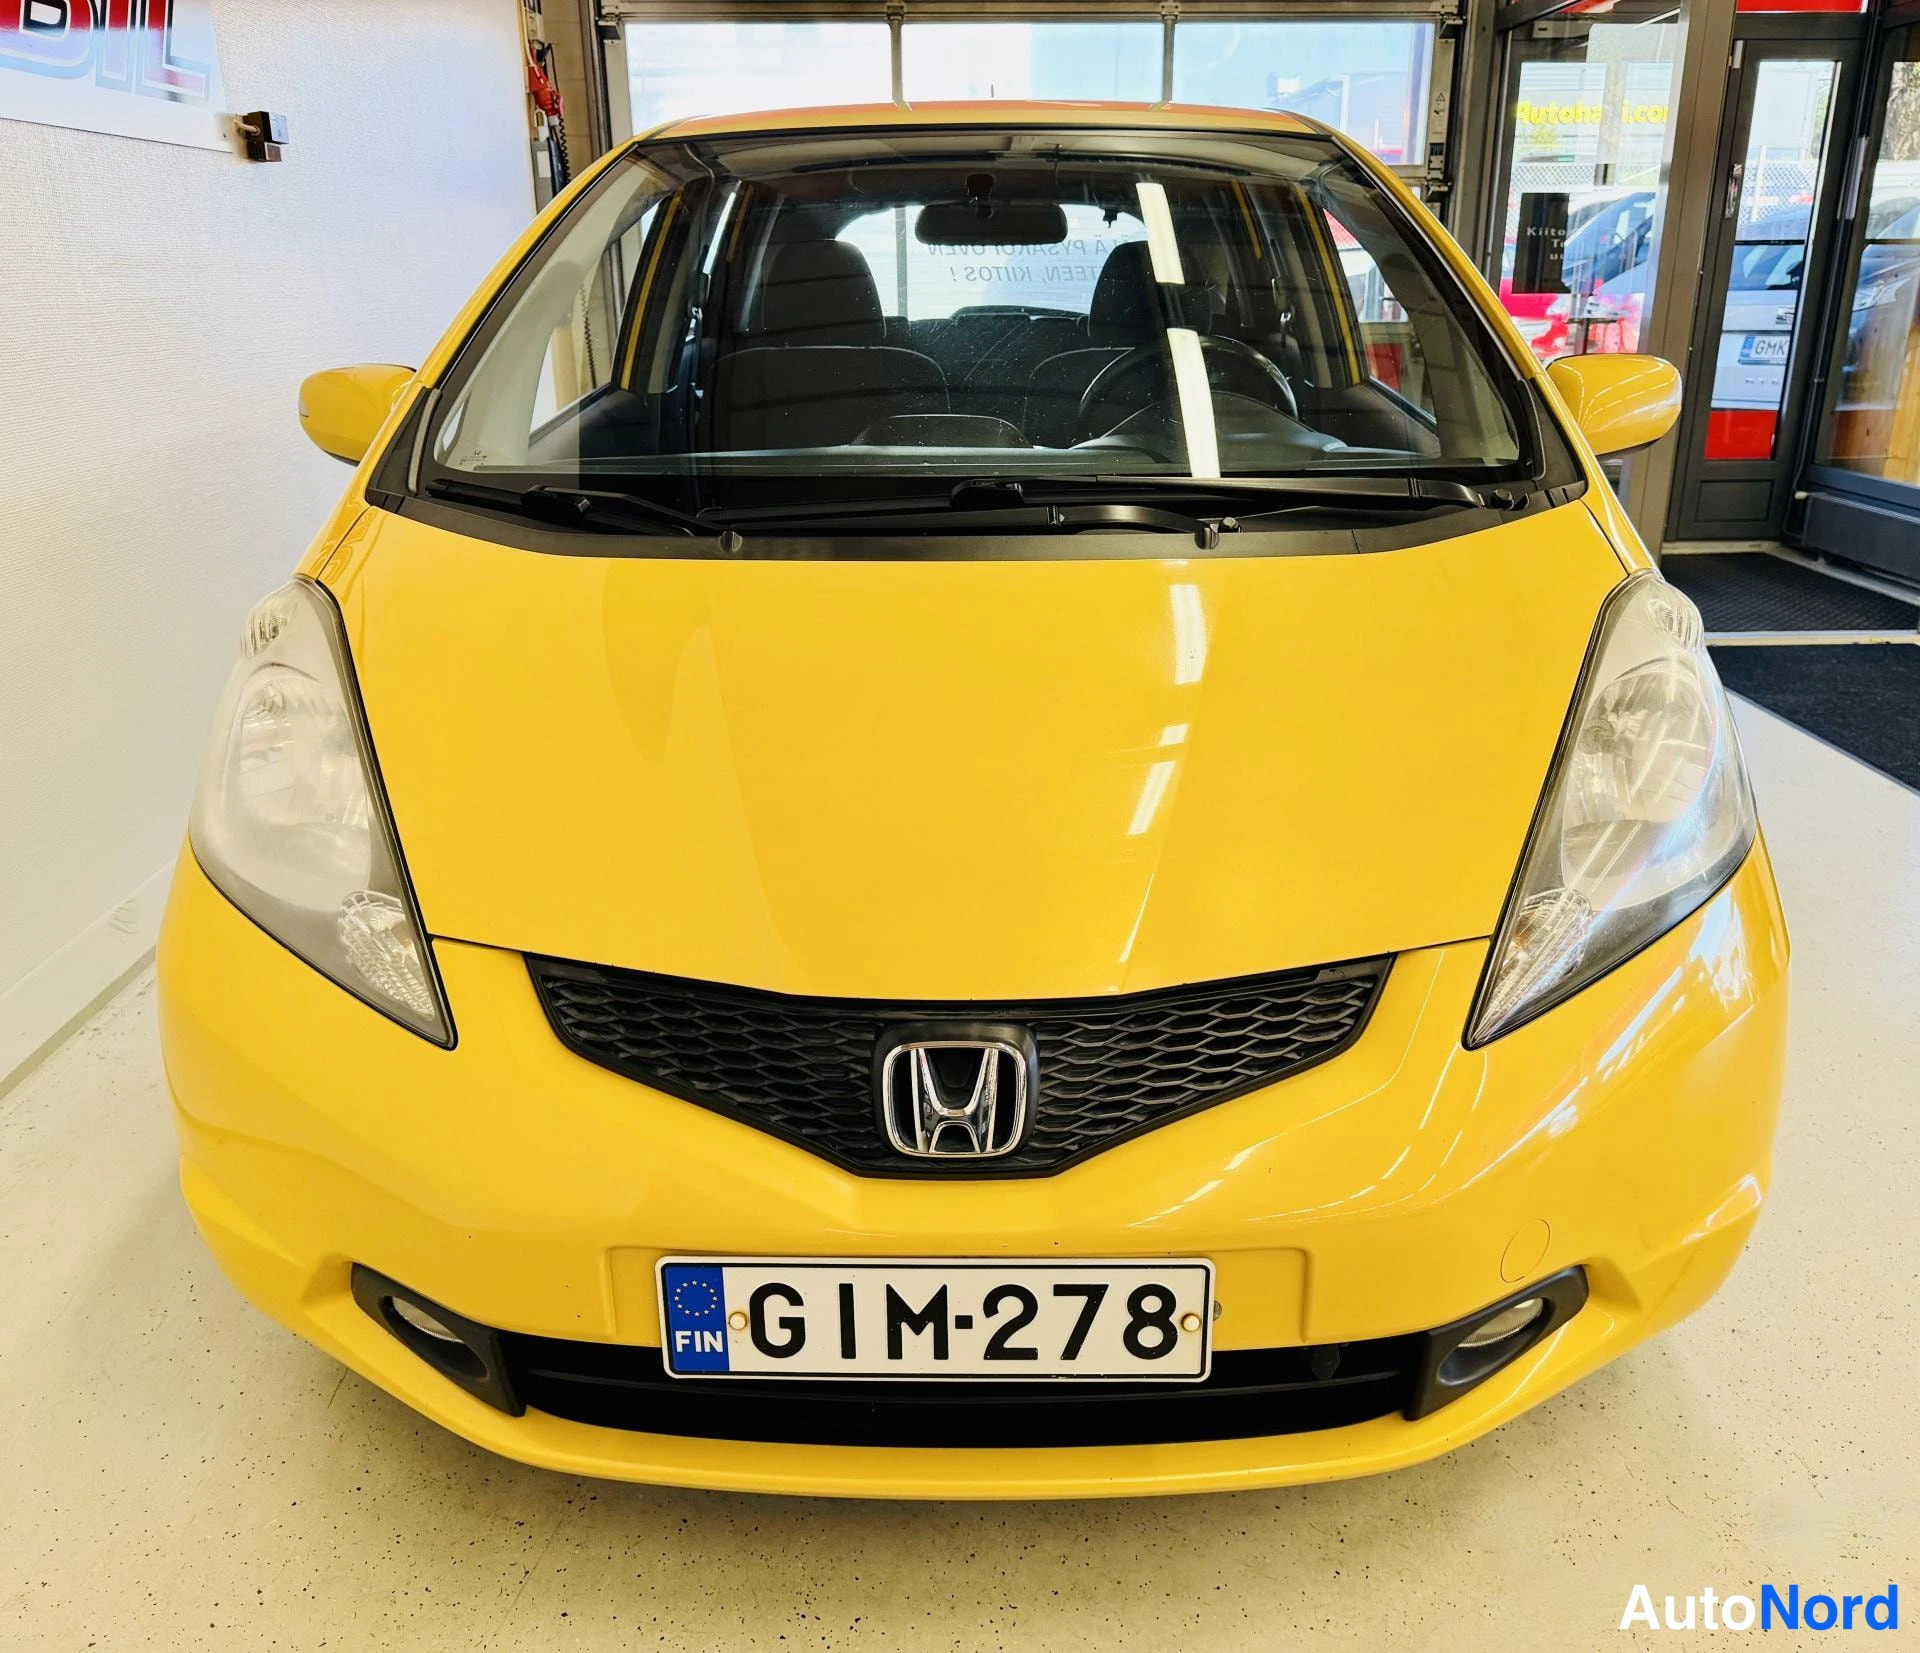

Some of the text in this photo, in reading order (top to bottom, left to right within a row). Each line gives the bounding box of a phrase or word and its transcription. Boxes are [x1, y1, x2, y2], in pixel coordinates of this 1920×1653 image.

[1526, 226, 1566, 237] Kiito
[675, 1282, 1177, 1361] FIN GIM-278
